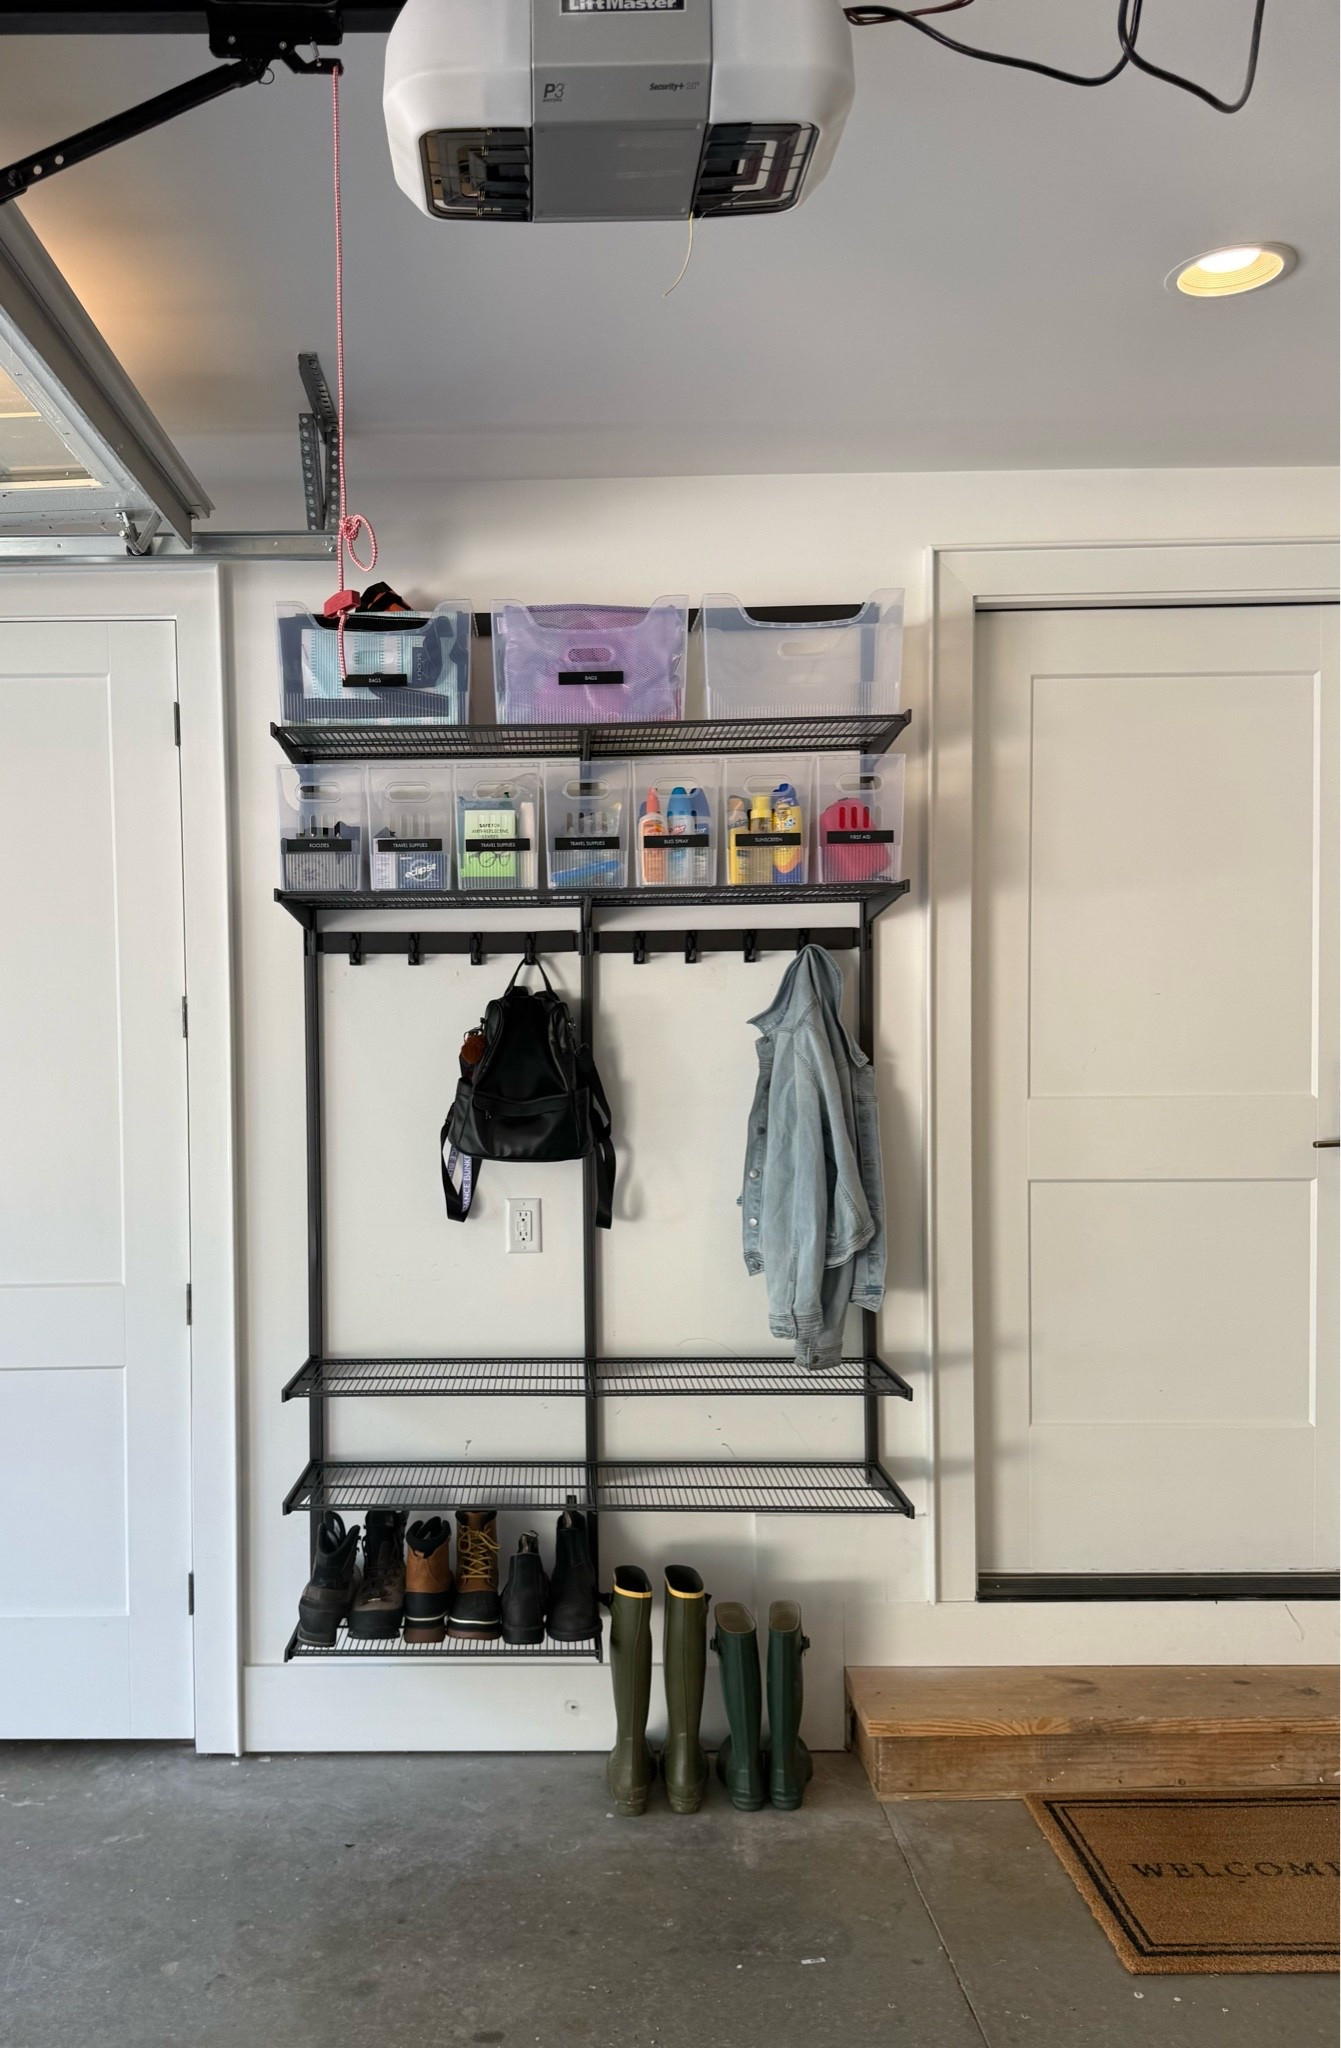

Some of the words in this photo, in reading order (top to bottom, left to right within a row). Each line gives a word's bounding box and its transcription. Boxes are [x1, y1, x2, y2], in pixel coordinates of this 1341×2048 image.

[569, 0, 676, 10] LiftMaster
[543, 83, 564, 98] P3
[405, 863, 436, 878] eclipse
